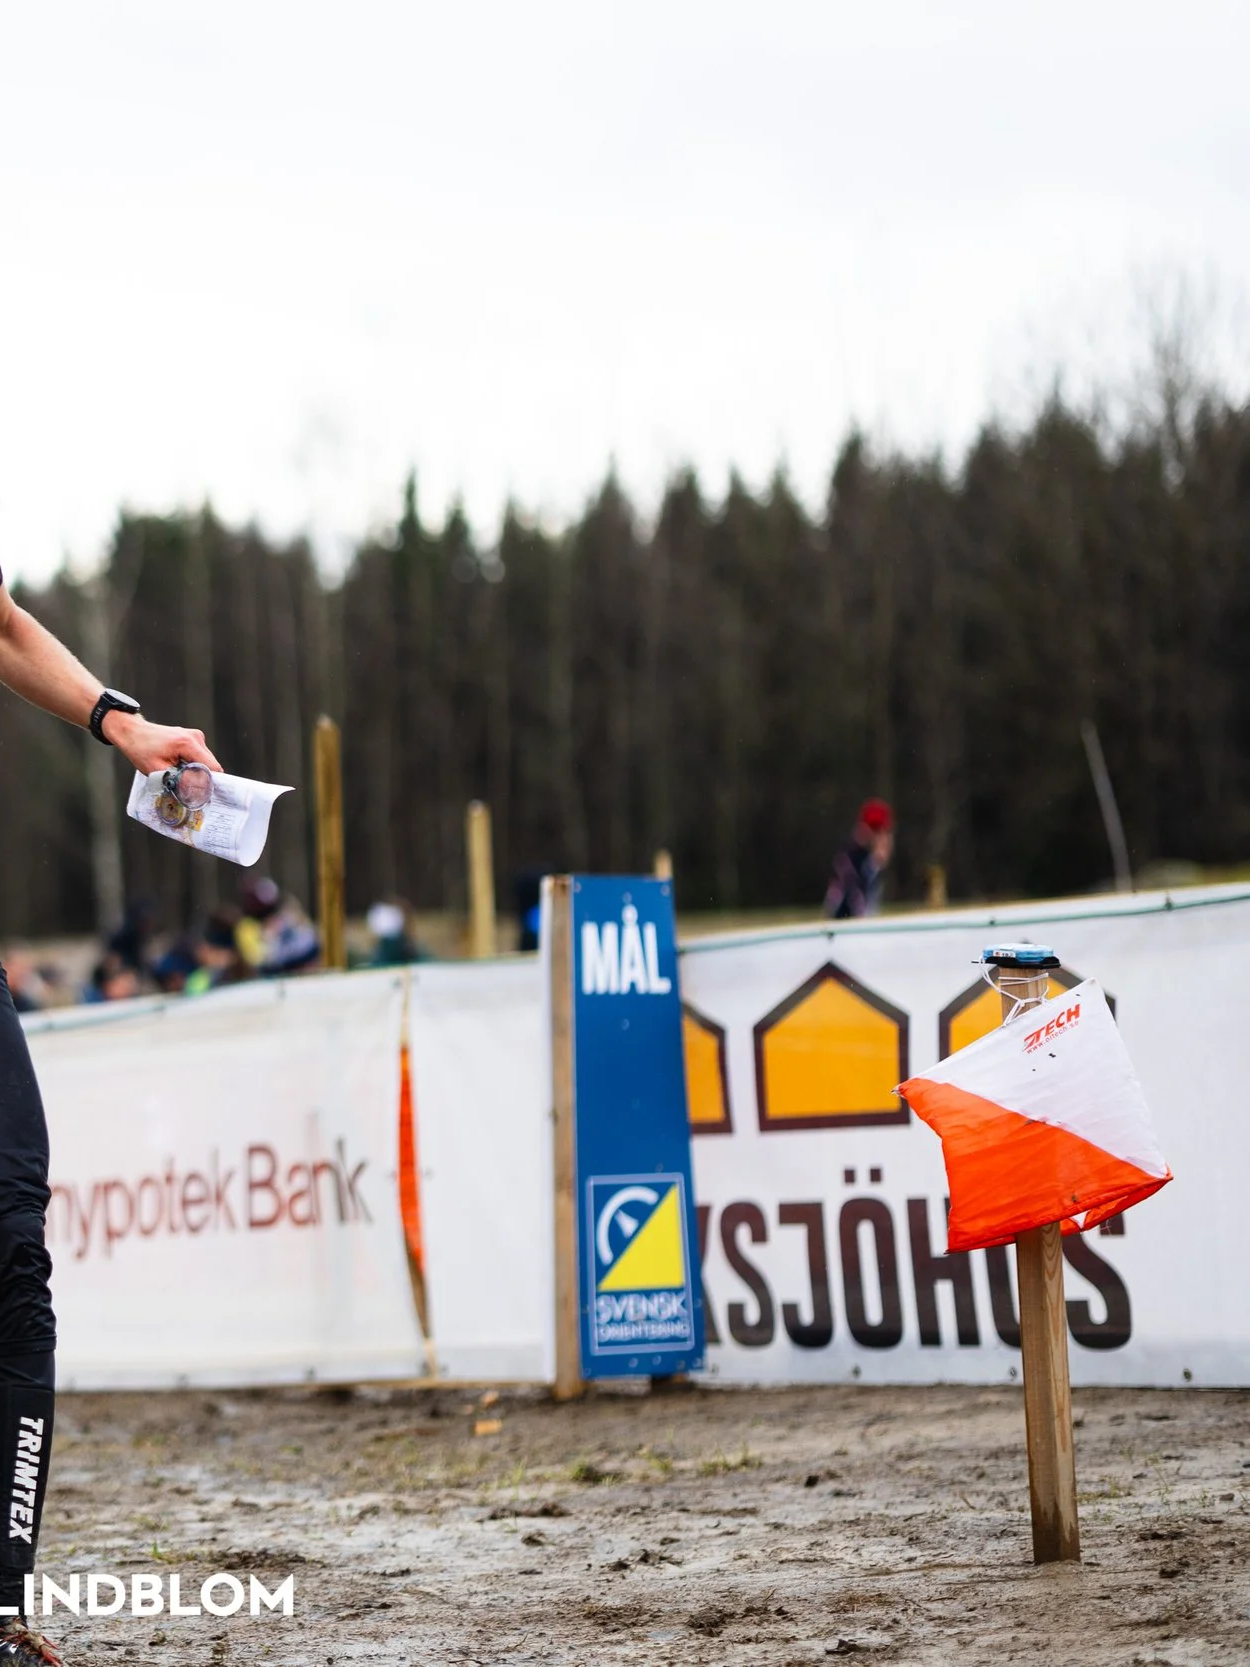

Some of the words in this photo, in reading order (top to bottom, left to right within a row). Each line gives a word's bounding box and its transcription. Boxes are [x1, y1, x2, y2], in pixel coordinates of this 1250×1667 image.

[581, 905, 671, 995] MÅL
[247, 1134, 373, 1231] Bank
[597, 1291, 688, 1324] SVENSK
[9, 1416, 44, 1545] TRIMTEX
